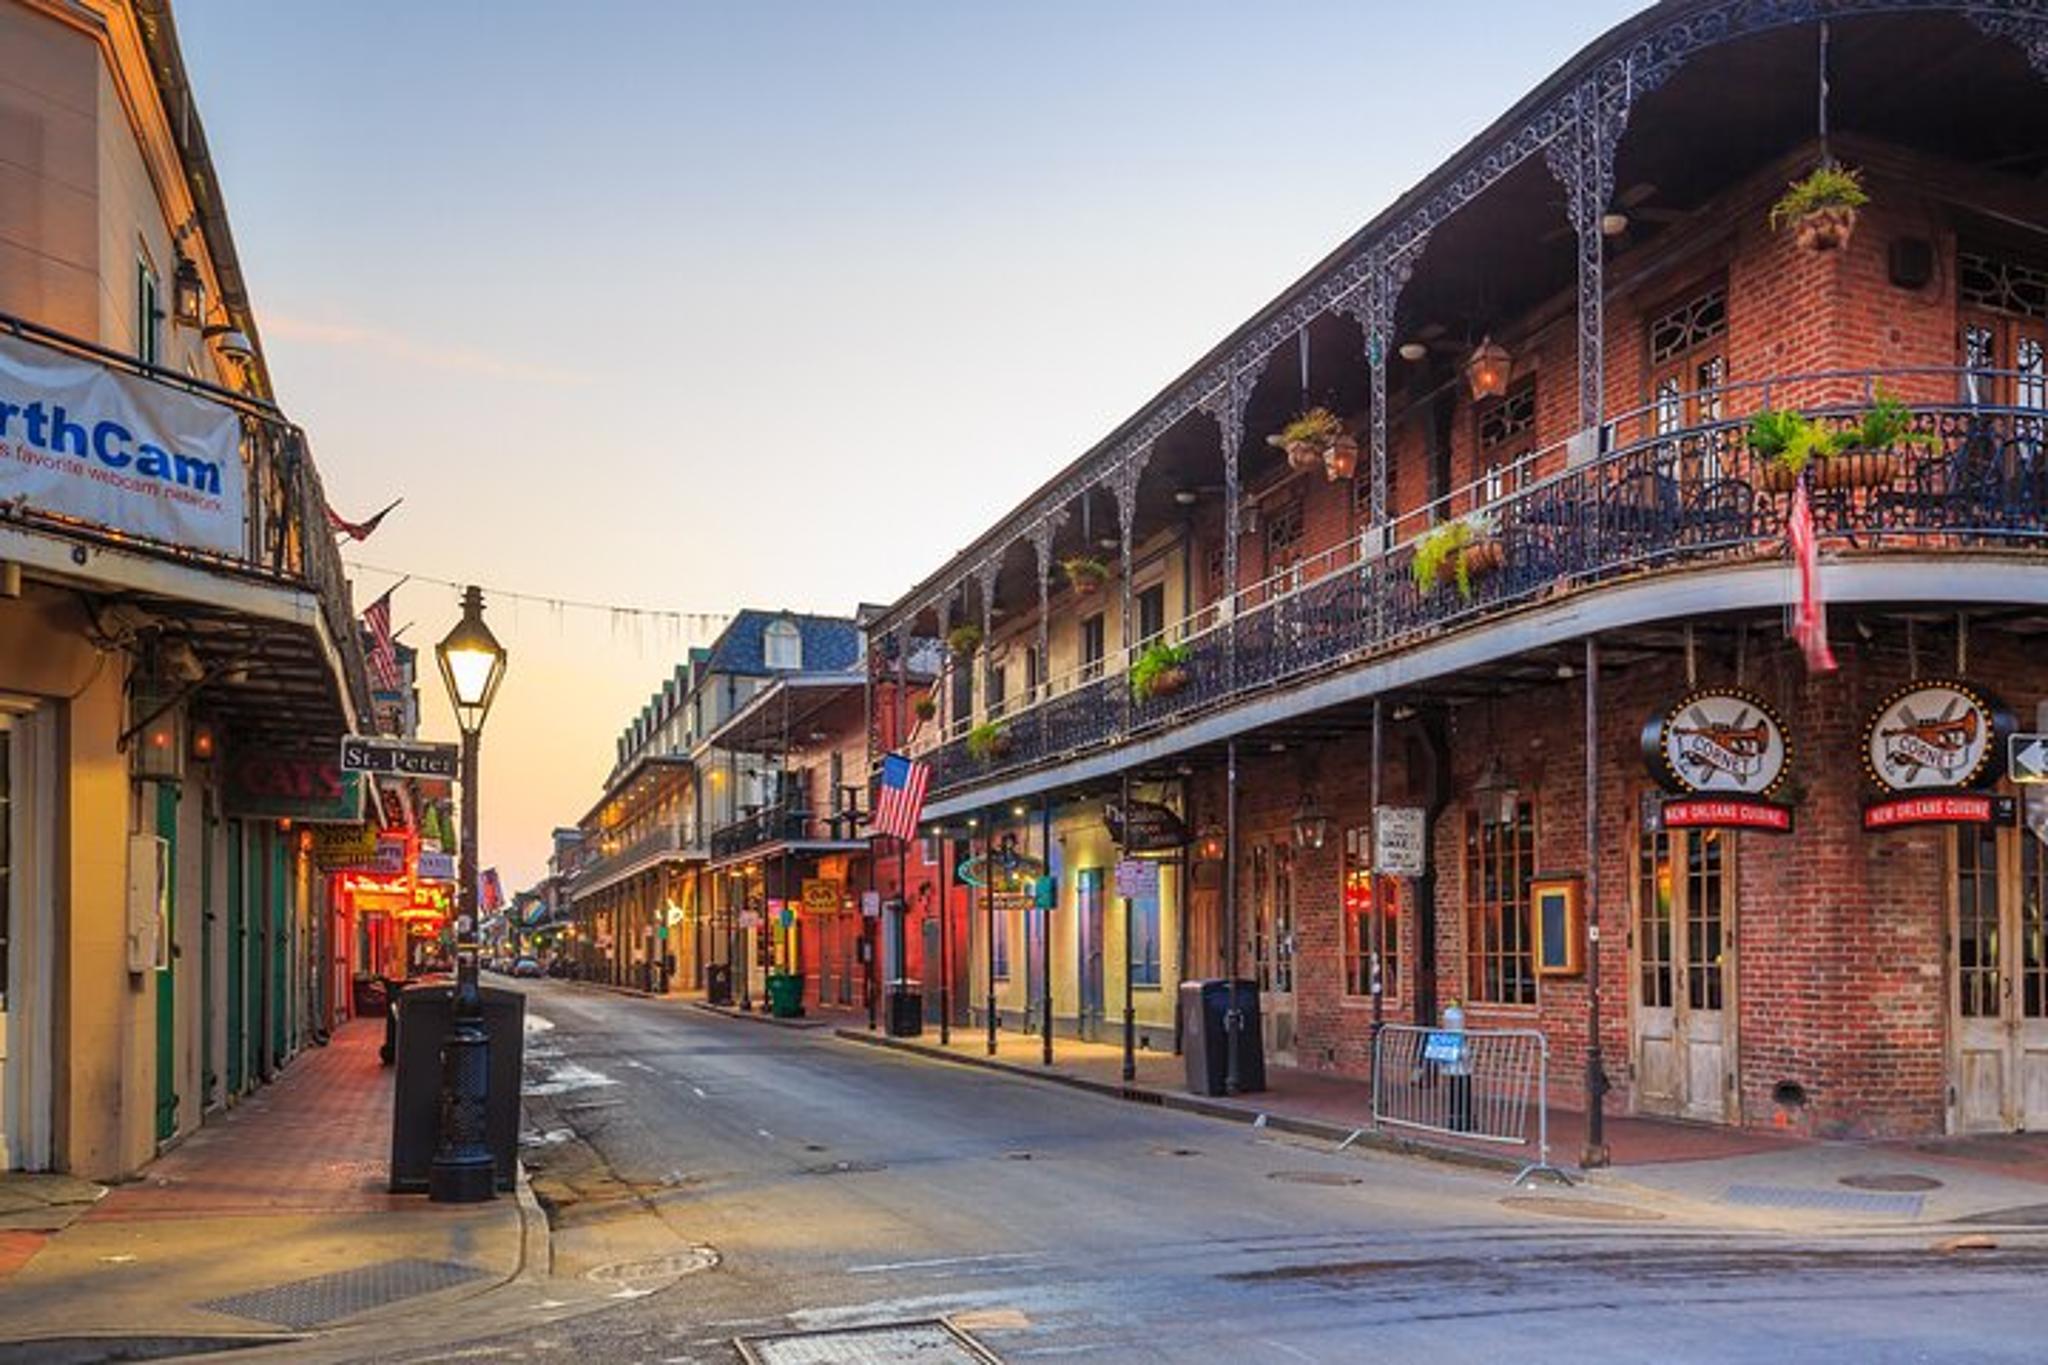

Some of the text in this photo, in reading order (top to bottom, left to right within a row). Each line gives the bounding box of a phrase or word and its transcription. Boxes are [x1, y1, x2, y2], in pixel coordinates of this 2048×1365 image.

[87, 467, 160, 497] webcam
[346, 748, 379, 766] St.
[1692, 737, 1748, 775] CORNET
[1901, 736, 1953, 769] CORNET
[1872, 808, 1893, 822] NEW
[1897, 801, 1943, 818] ORLEANS
